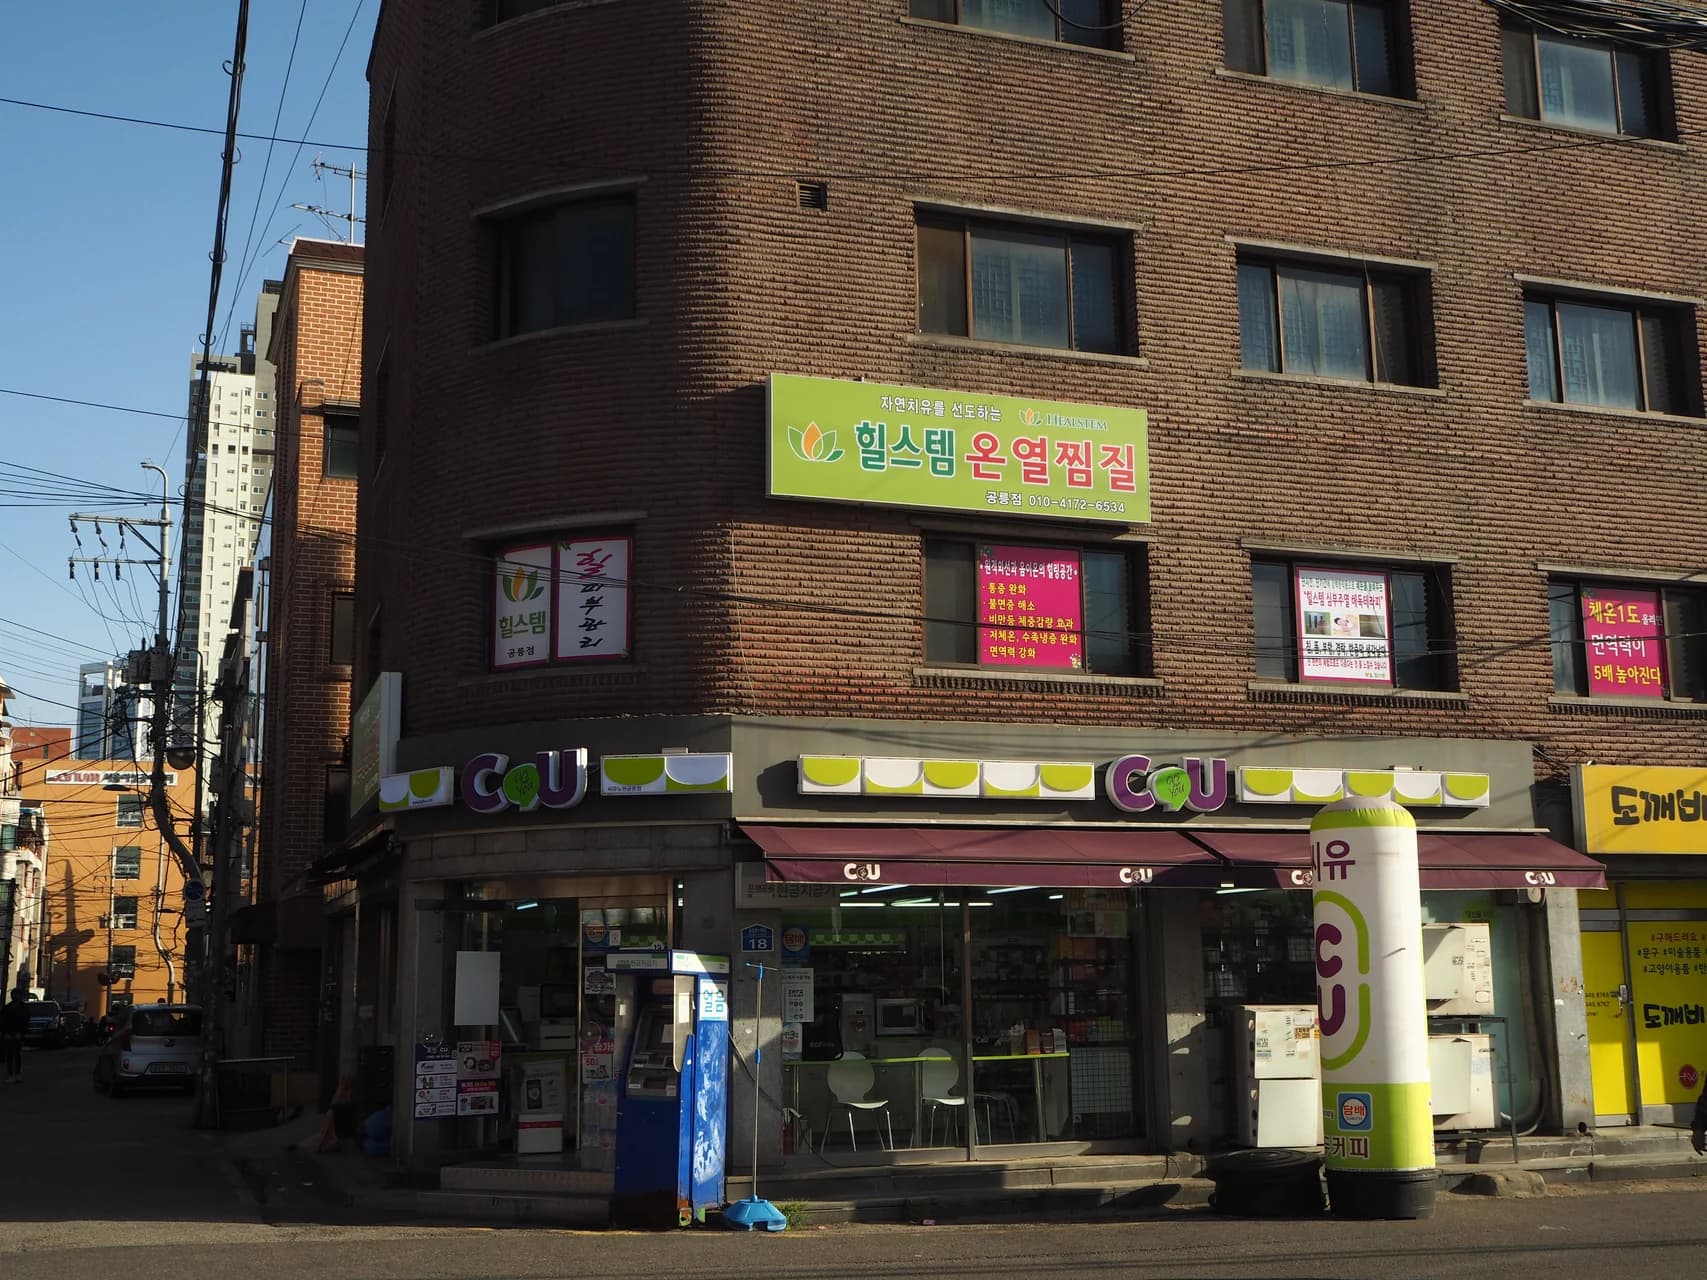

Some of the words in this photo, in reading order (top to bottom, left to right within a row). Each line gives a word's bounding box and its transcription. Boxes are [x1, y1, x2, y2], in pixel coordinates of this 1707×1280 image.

[881, 396, 945, 417] 자연치유를
[951, 402, 1001, 422] 선도하는
[854, 420, 956, 478] 힐스템
[986, 491, 1022, 506] 공릉점
[1029, 495, 1125, 513] 010-4172-6534
[1047, 562, 1073, 580] 힐링공간
[988, 582, 1006, 595] 통증
[1018, 599, 1035, 611] 해소
[1588, 601, 1640, 624] 체온1도
[498, 611, 547, 639] 힐스템
[1018, 615, 1053, 628] 체중감량
[1018, 647, 1035, 659] 강화
[1594, 664, 1614, 683] 5배
[1616, 665, 1662, 686] 높아진다
[461, 747, 588, 813] CU
[1105, 754, 1227, 812] CU
[844, 862, 880, 880] CU
[1119, 867, 1153, 883] CU
[1291, 870, 1313, 885] C
[1525, 871, 1556, 885] CU
[749, 938, 768, 949] 18
[1643, 1003, 1705, 1029] 도깨비
[1343, 1105, 1365, 1117] 담배
